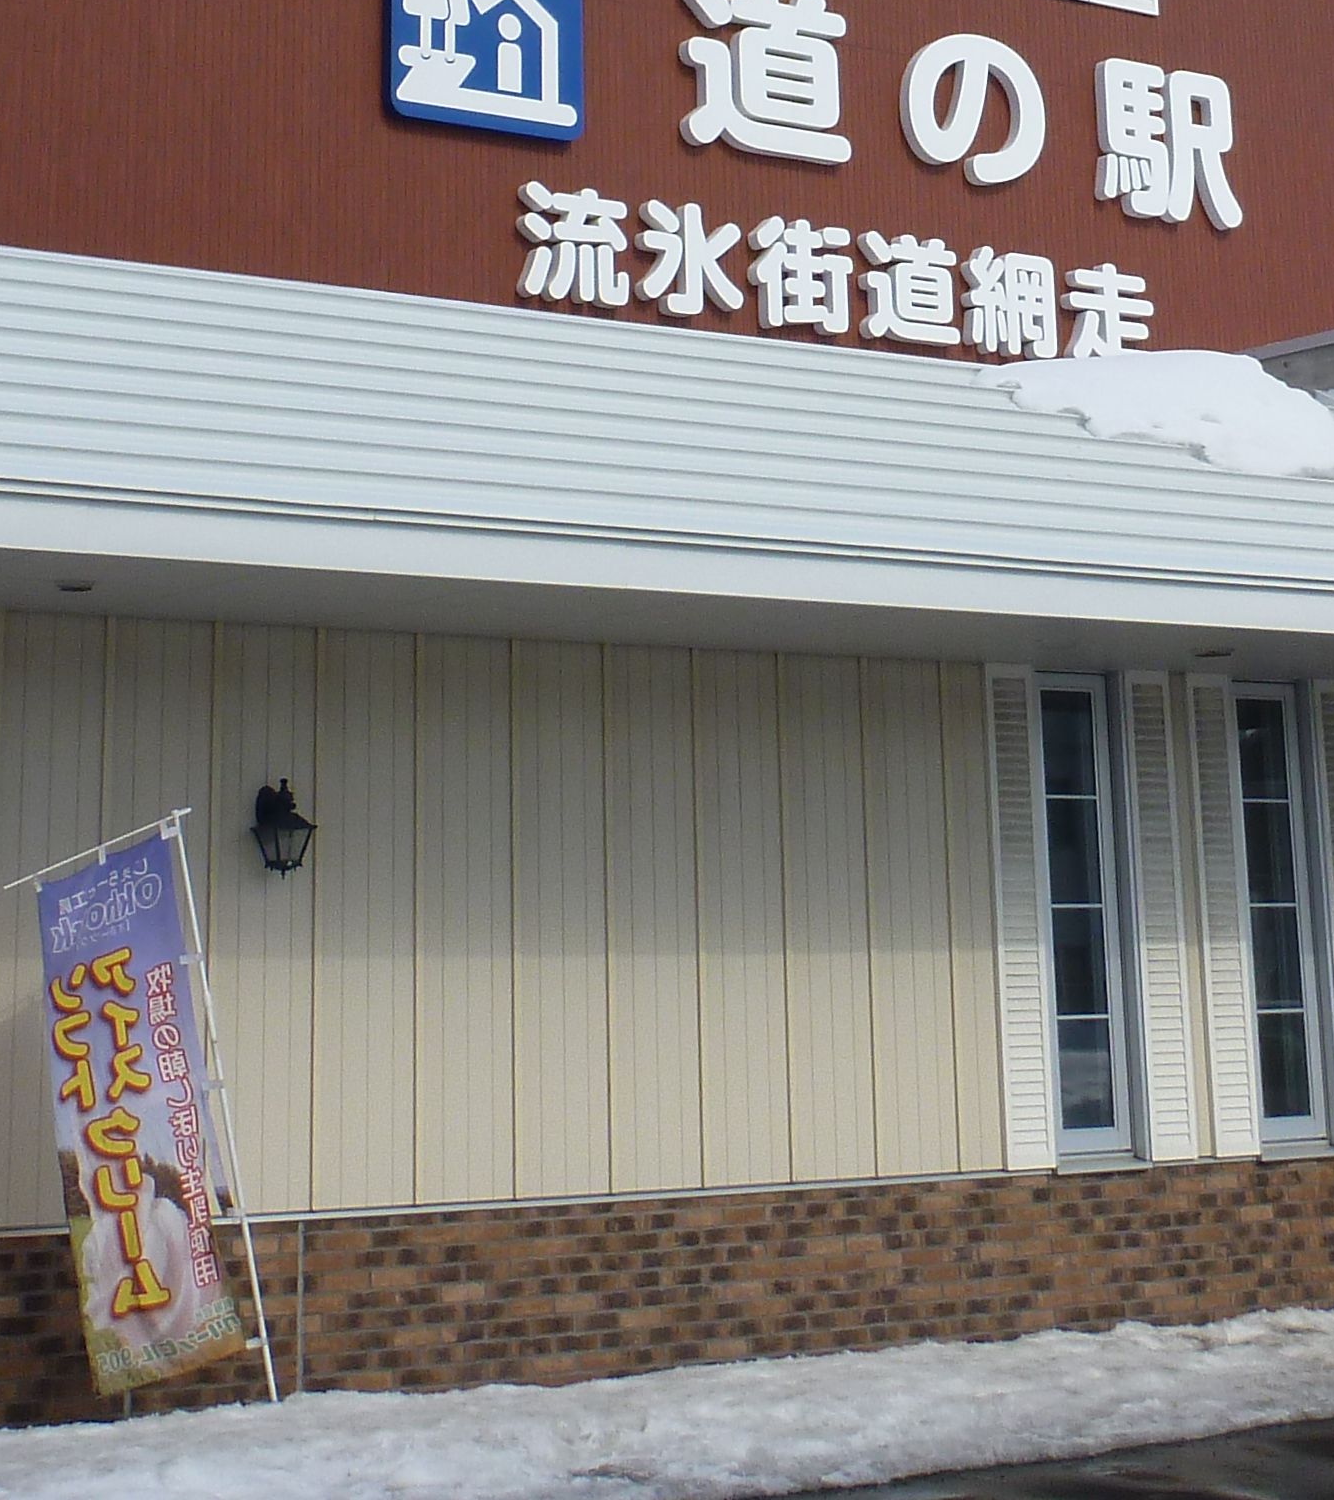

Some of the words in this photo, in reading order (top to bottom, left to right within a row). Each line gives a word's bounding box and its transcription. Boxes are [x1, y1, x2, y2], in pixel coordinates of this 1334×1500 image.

[517, 180, 1155, 360] 流氷街道網走
